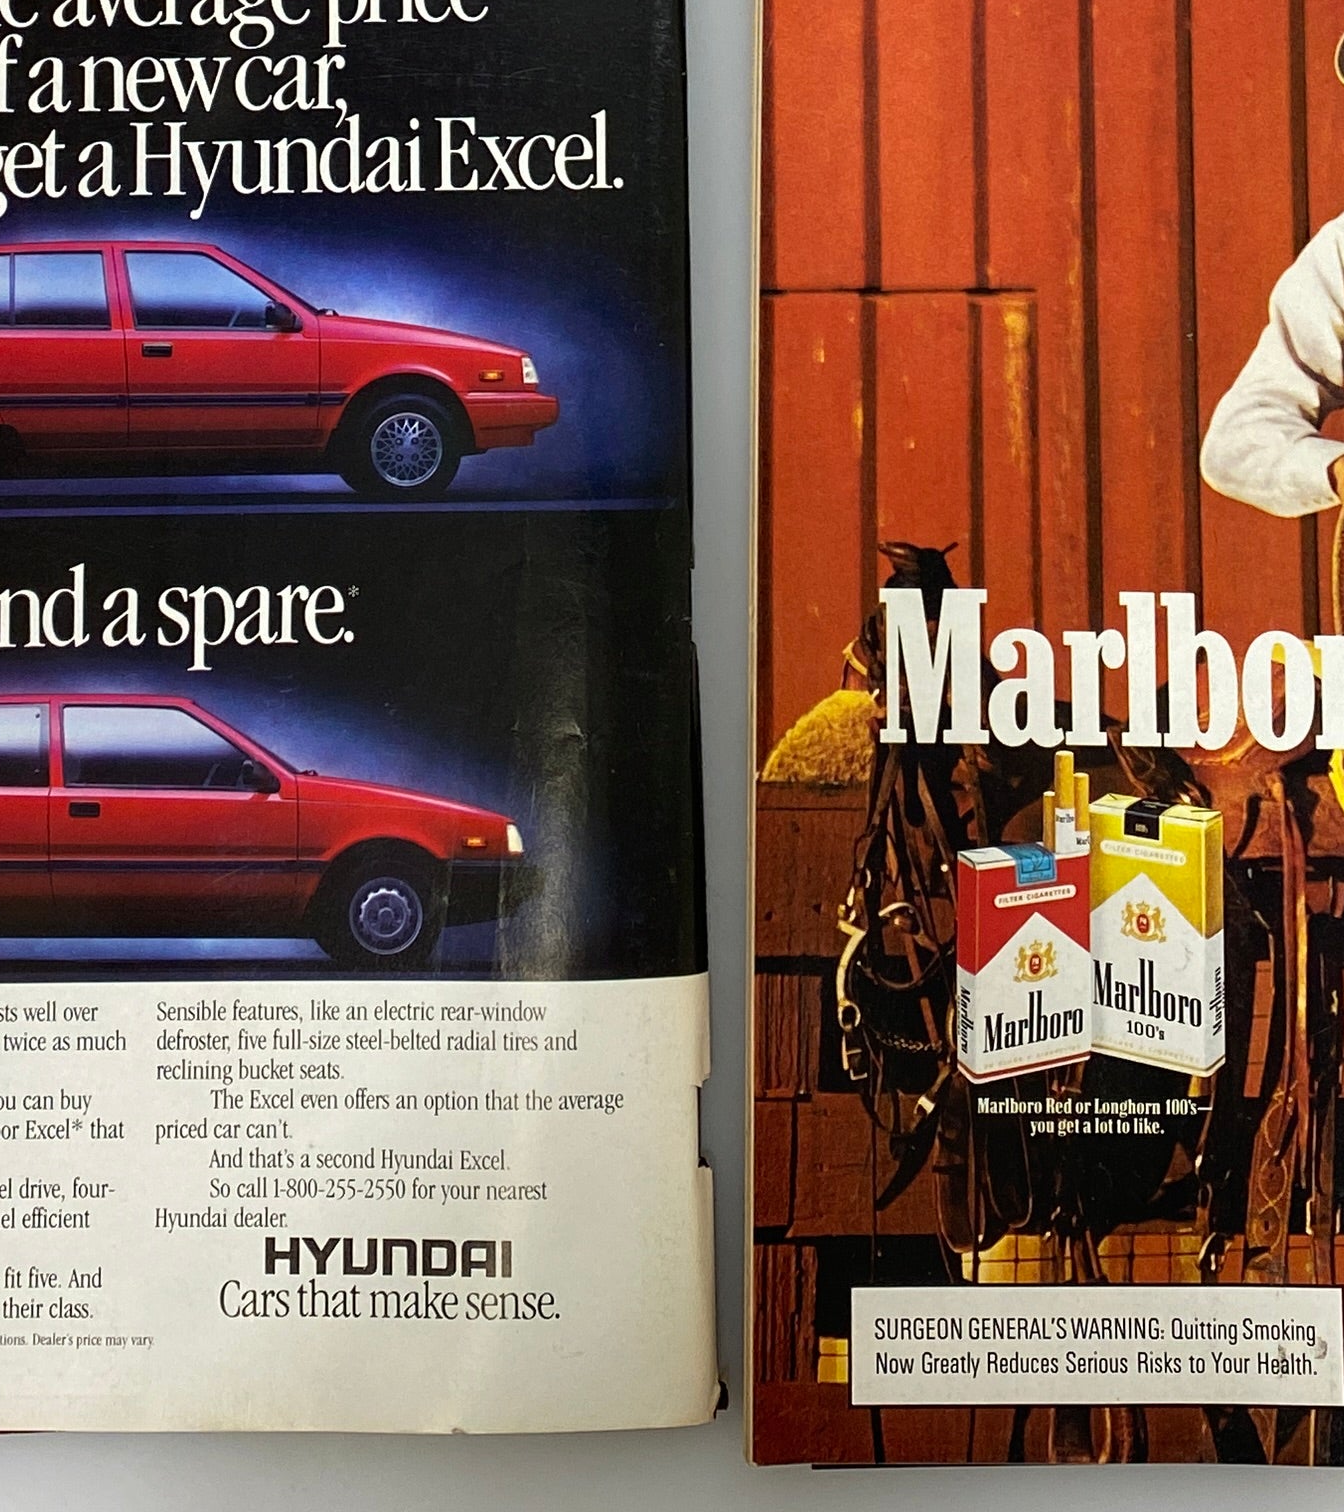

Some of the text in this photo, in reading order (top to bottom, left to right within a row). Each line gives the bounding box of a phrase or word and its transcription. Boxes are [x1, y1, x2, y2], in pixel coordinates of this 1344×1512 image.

[28, 57, 71, 113] a
[79, 56, 231, 112] new
[234, 54, 348, 126] car,
[78, 141, 121, 197] a
[129, 117, 425, 220] Hyundai
[435, 110, 623, 191] Excel.
[103, 588, 146, 647] a
[1093, 958, 1202, 1028] Marlboro
[983, 990, 1084, 1053] Marlboro
[1126, 1020, 1165, 1041] 100's
[978, 1098, 1042, 1113] Marlboro
[1046, 1098, 1072, 1114] Red
[1076, 1102, 1091, 1114] or
[1095, 1098, 1160, 1118] Longhorn
[1031, 1118, 1164, 1136] you get a lot to like.
[265, 1237, 511, 1277] HYUNDAI
[220, 1280, 560, 1320] Cars that make sense.
[875, 1317, 1315, 1346] SURGEON GENERAL'S WARNING: Quitting Smoking
[876, 1351, 1318, 1378] Now Greatly Reduces Serious Risks to Your Health.
